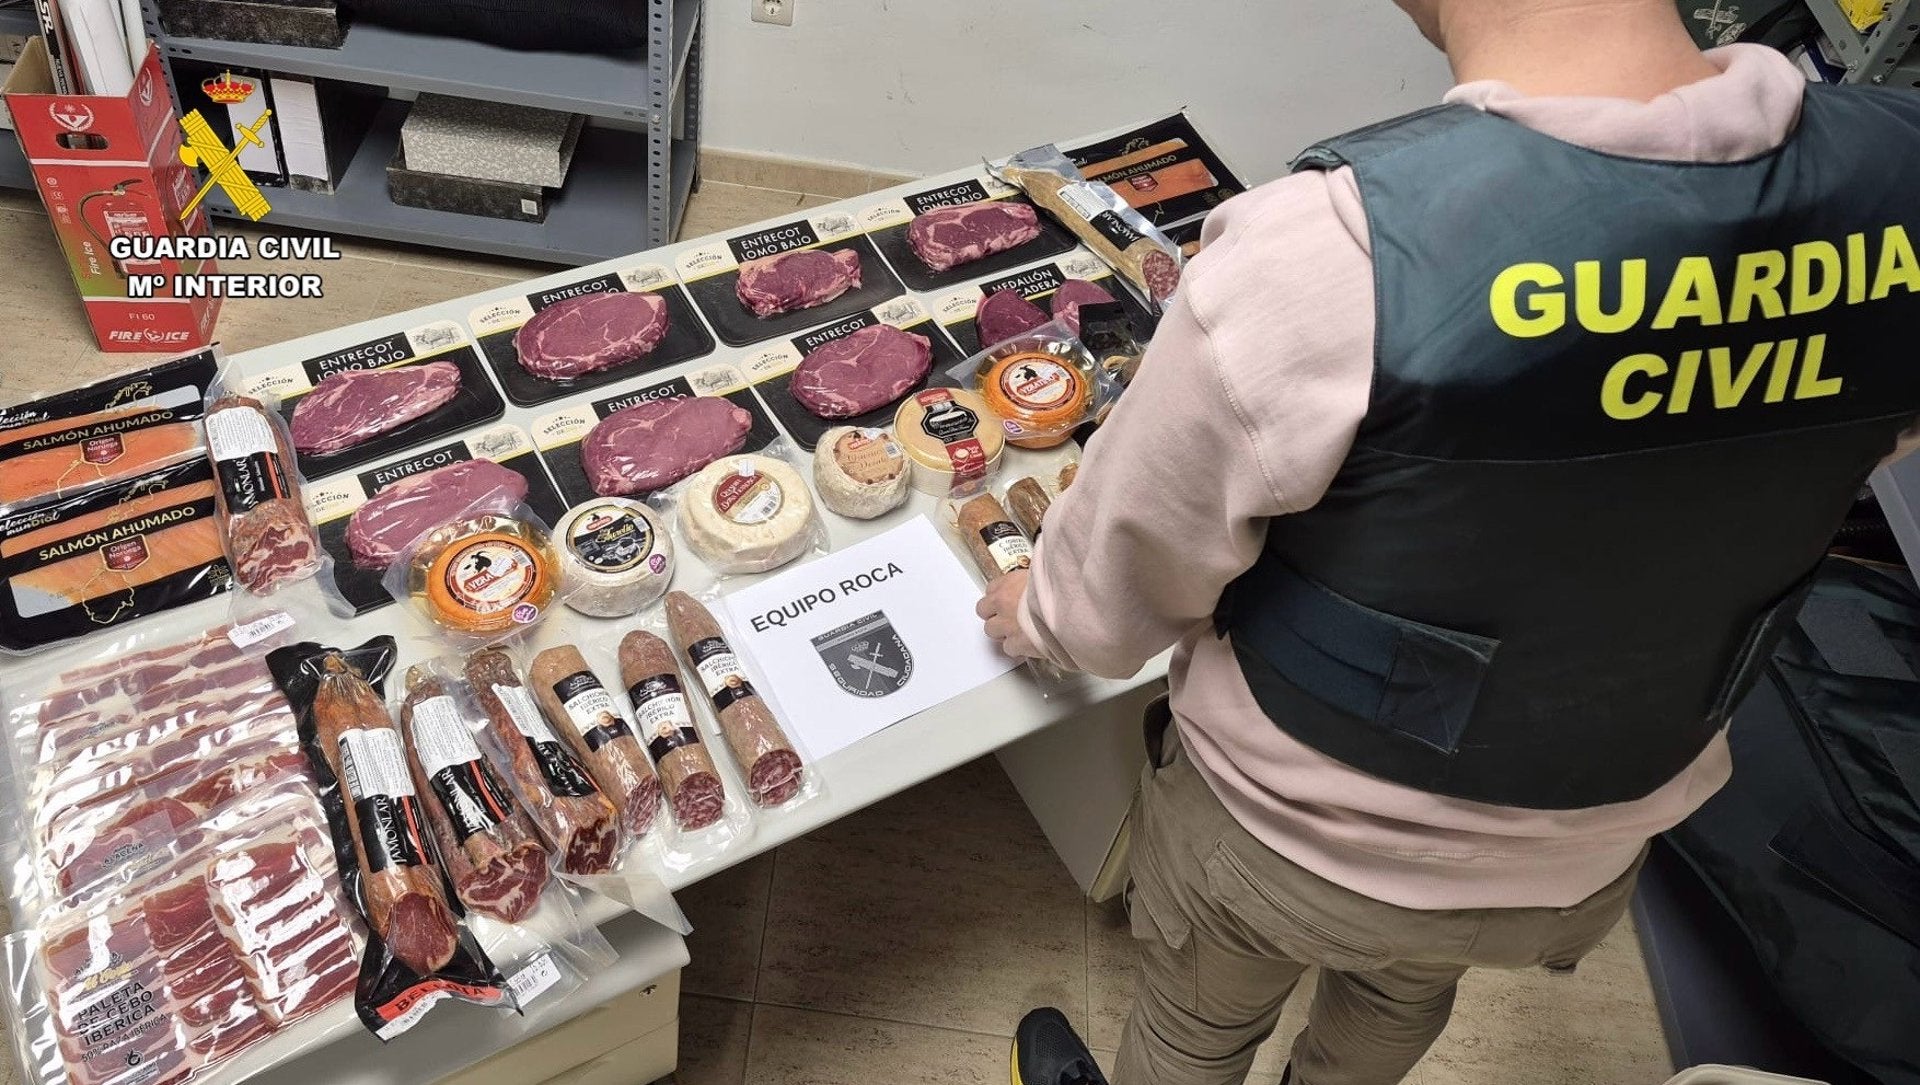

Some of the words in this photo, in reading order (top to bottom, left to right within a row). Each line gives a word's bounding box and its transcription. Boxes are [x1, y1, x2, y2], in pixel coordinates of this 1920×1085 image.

[1128, 154, 1177, 175] AHUMADO
[916, 185, 972, 205] ENTRECOT
[954, 192, 982, 205] BAJO
[741, 227, 801, 250] ENTRECOT
[741, 245, 778, 261] LOMO
[780, 235, 812, 251] BAJO
[541, 279, 608, 304] ENTRECOT
[1489, 224, 1920, 338] GUARDIA
[109, 331, 142, 341] FIRE
[165, 331, 190, 341] ICE
[805, 318, 866, 346] ENTRECOT
[319, 341, 394, 370] ENTRECOT
[367, 350, 405, 368] BAJO
[1600, 333, 1843, 420] CIVIL
[607, 384, 677, 412] ENTRECOT
[23, 429, 90, 450] SALMÓN
[93, 411, 174, 435] AHUMADO
[89, 437, 115, 446] Origen
[375, 450, 453, 484] ENTRECOT
[39, 532, 109, 560] SALMÓN
[112, 507, 196, 540] AHUMADO
[110, 541, 137, 553] Origen
[750, 586, 837, 633] EQUIPO
[839, 562, 904, 597] ROCA
[818, 622, 856, 641] GUARDIA
[857, 613, 878, 624] CIVIL
[891, 634, 912, 686] CIUDADANA
[829, 663, 884, 697] SEGURIDAD
[585, 702, 610, 715] EXTRA
[649, 711, 675, 724] EXTRA
[376, 797, 408, 864] JAMONLAR
[77, 1016, 99, 1034] DE
[106, 990, 153, 1020] CEBO
[78, 982, 145, 1019] PALETA
